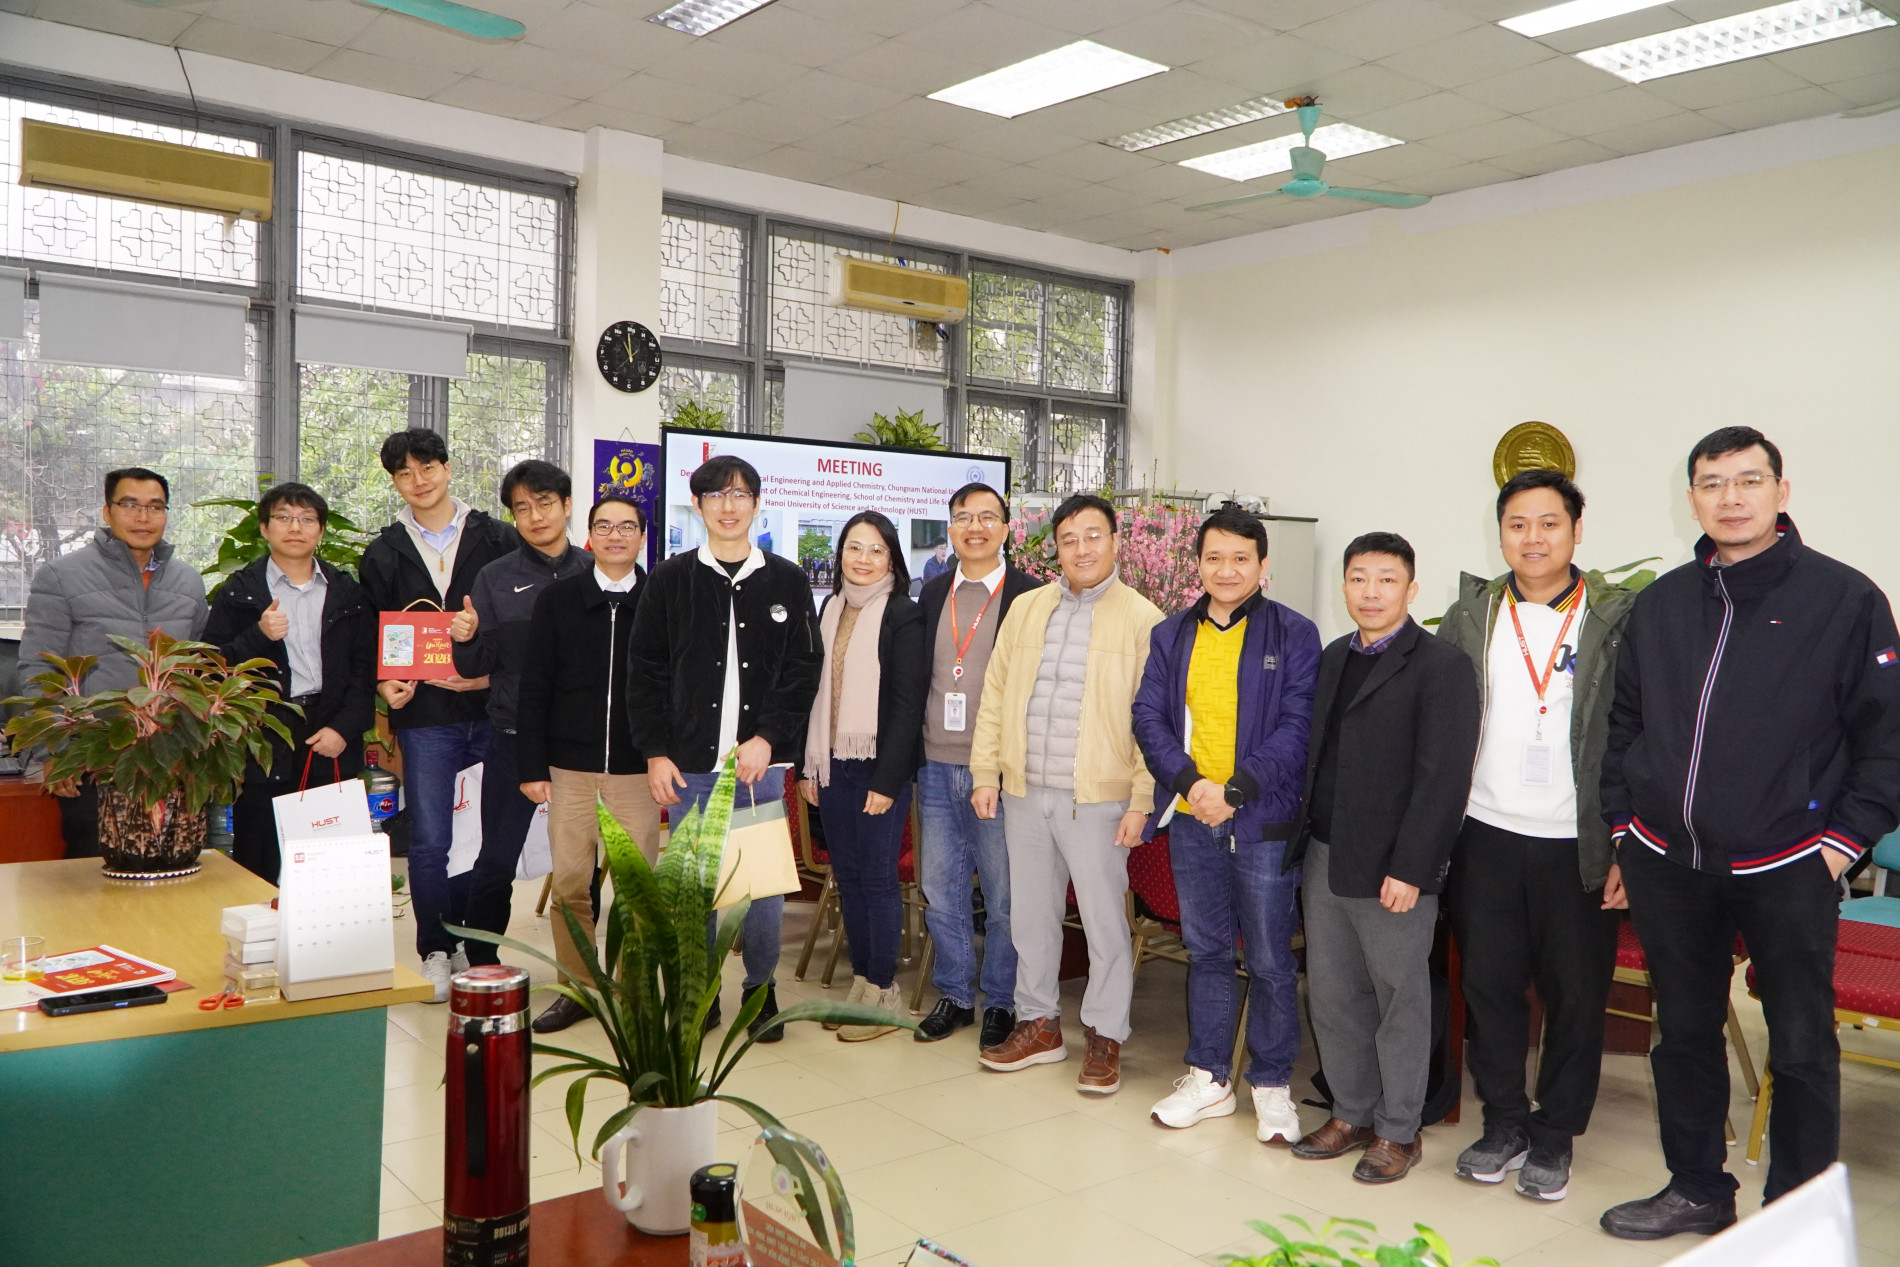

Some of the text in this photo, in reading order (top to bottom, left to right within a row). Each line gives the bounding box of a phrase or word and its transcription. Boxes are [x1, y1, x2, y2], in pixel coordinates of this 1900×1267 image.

[817, 458, 883, 477] MEETING
[770, 475, 811, 486] Engineering
[812, 478, 825, 486] and
[826, 479, 852, 488] Applied
[853, 481, 887, 491] Chemistry,
[887, 483, 921, 493] Chungnam
[921, 486, 947, 495] National
[779, 487, 810, 497] Chemical
[811, 489, 851, 500] Engineering,
[853, 492, 875, 501] School
[884, 494, 915, 504] Chemistry
[917, 497, 928, 505] and
[929, 497, 940, 505] Life
[765, 499, 786, 507] Hanoi
[787, 500, 821, 510] University
[831, 502, 856, 511] Science
[871, 505, 906, 514] Technology
[907, 507, 928, 516] (HUST)
[423, 653, 451, 664] 2026
[311, 816, 340, 829] HUST
